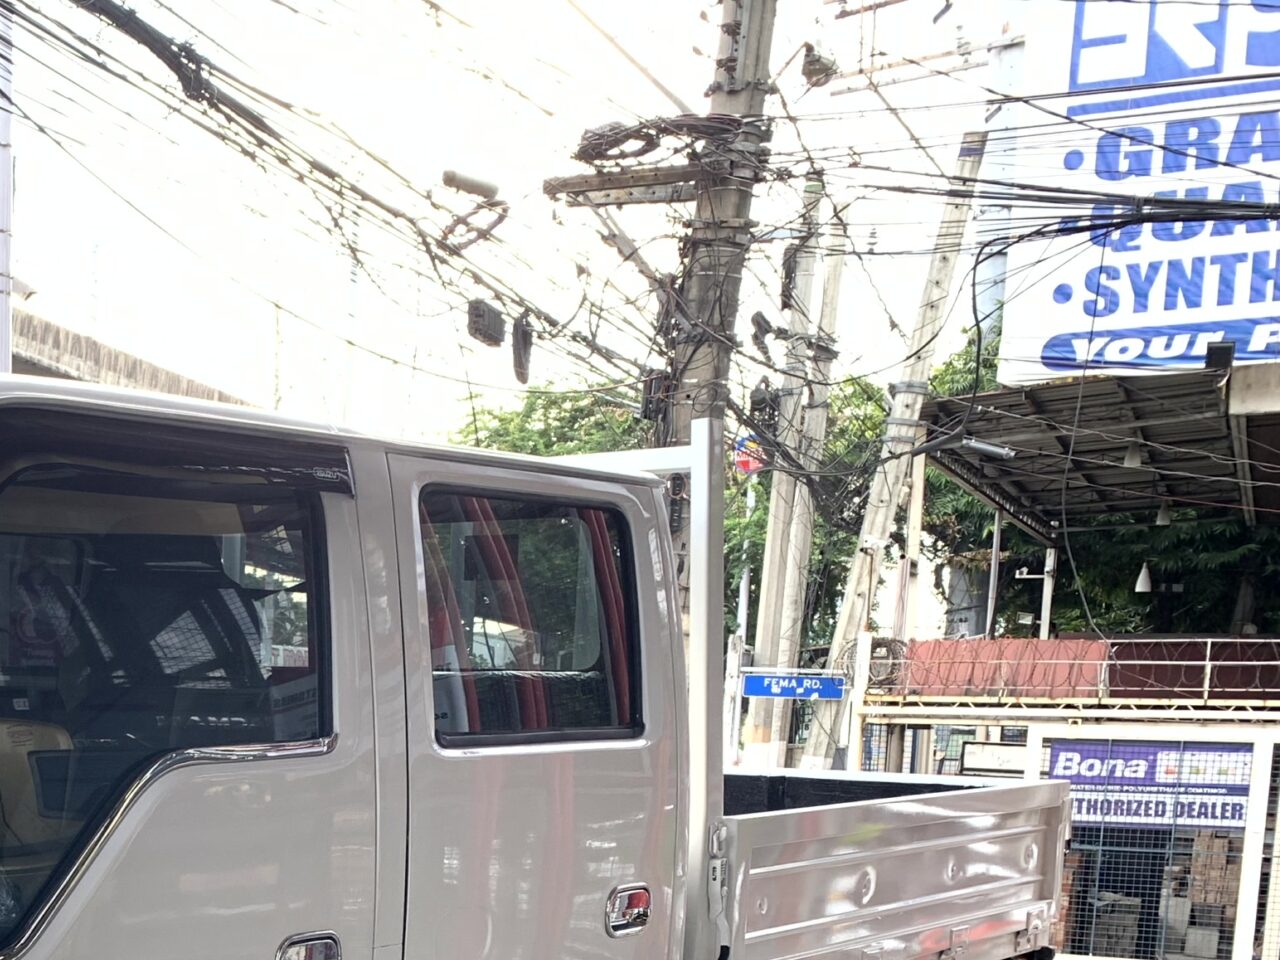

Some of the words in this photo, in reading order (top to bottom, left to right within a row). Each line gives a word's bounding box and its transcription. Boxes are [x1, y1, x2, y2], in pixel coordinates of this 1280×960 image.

[1089, 182, 1280, 252] QUA
[764, 677, 797, 688] FEMA
[803, 678, 823, 689] RD.
[1053, 751, 1148, 778] Bona
[1071, 797, 1167, 818] THORIZED
[1175, 800, 1244, 820] DEALER
